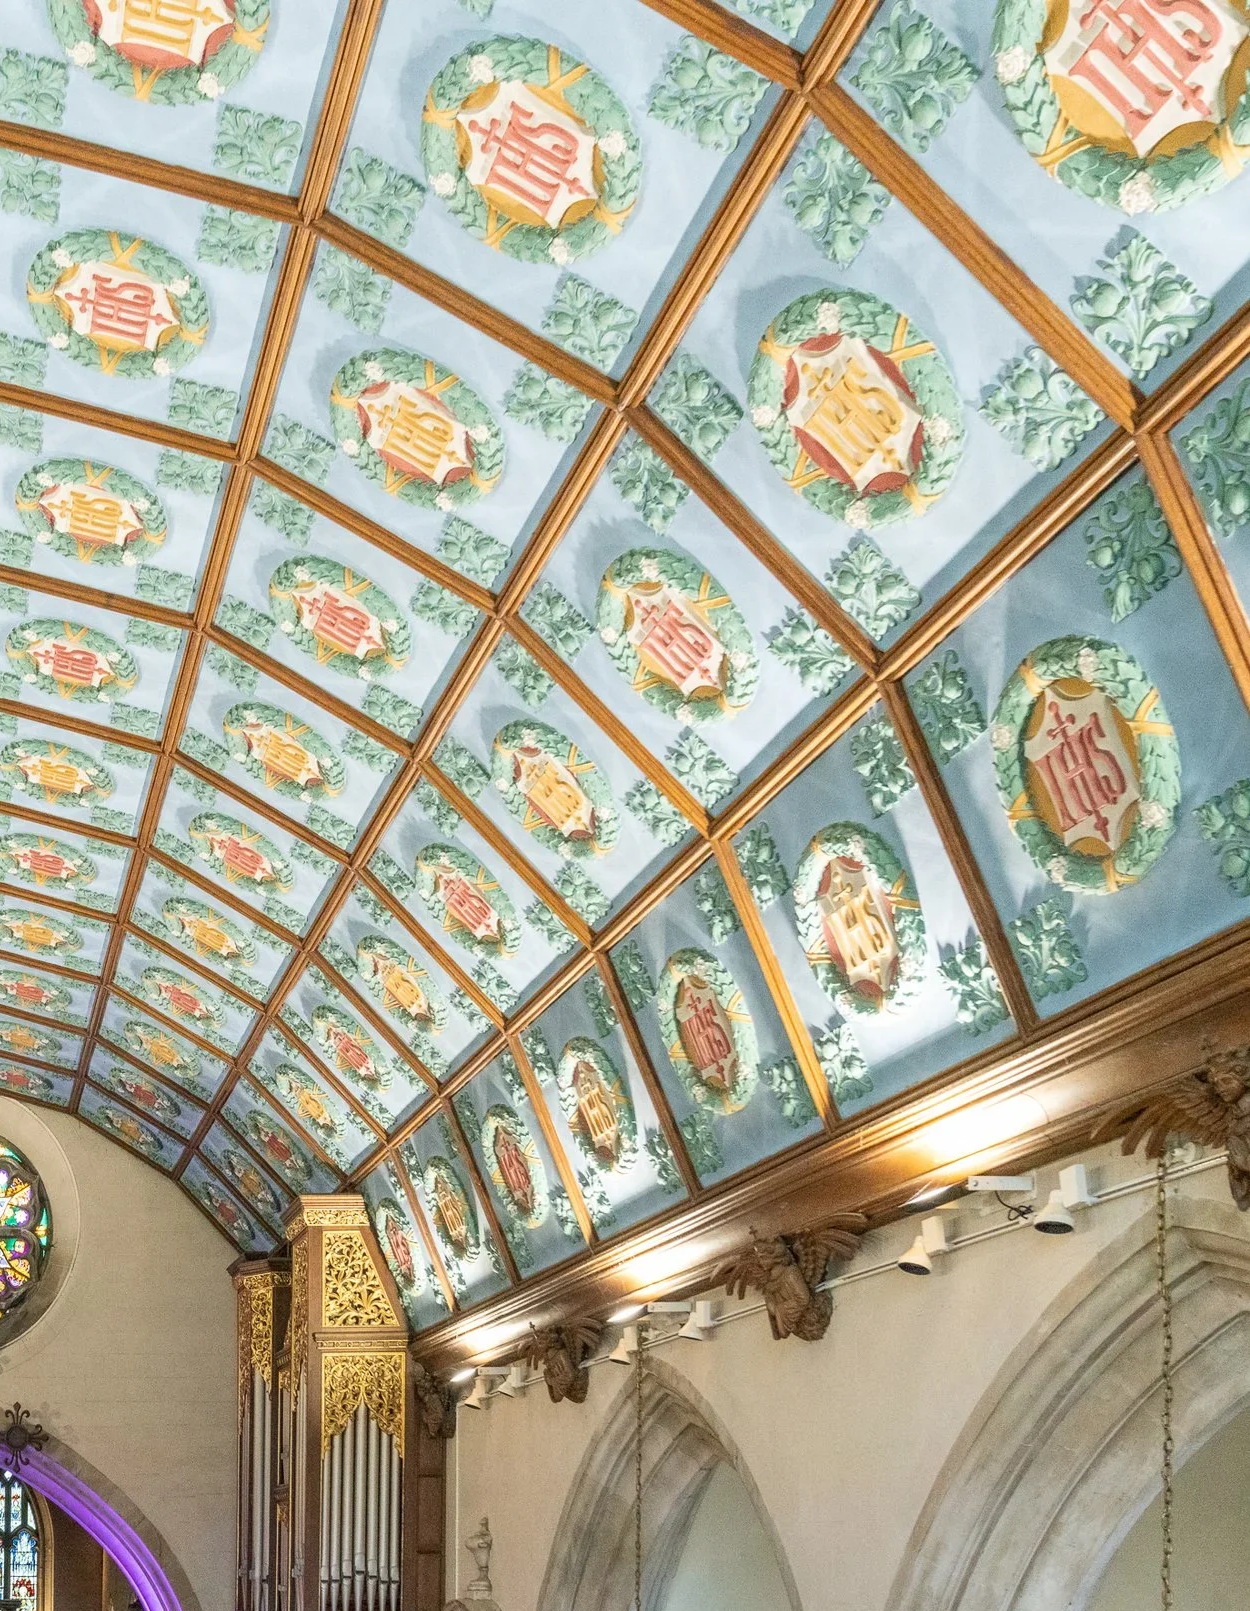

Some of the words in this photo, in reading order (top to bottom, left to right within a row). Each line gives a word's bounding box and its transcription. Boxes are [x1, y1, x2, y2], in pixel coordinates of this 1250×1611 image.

[468, 102, 590, 215] IHS
[63, 274, 172, 346] IHS
[366, 393, 468, 478] IHS
[802, 360, 900, 478] IHS
[53, 491, 136, 541] IHS
[36, 643, 111, 683] IHS
[300, 592, 382, 652] IHS
[642, 600, 718, 688] IHS
[249, 731, 322, 784] IHS
[1037, 702, 1125, 842] IHS
[682, 997, 733, 1085] IHS
